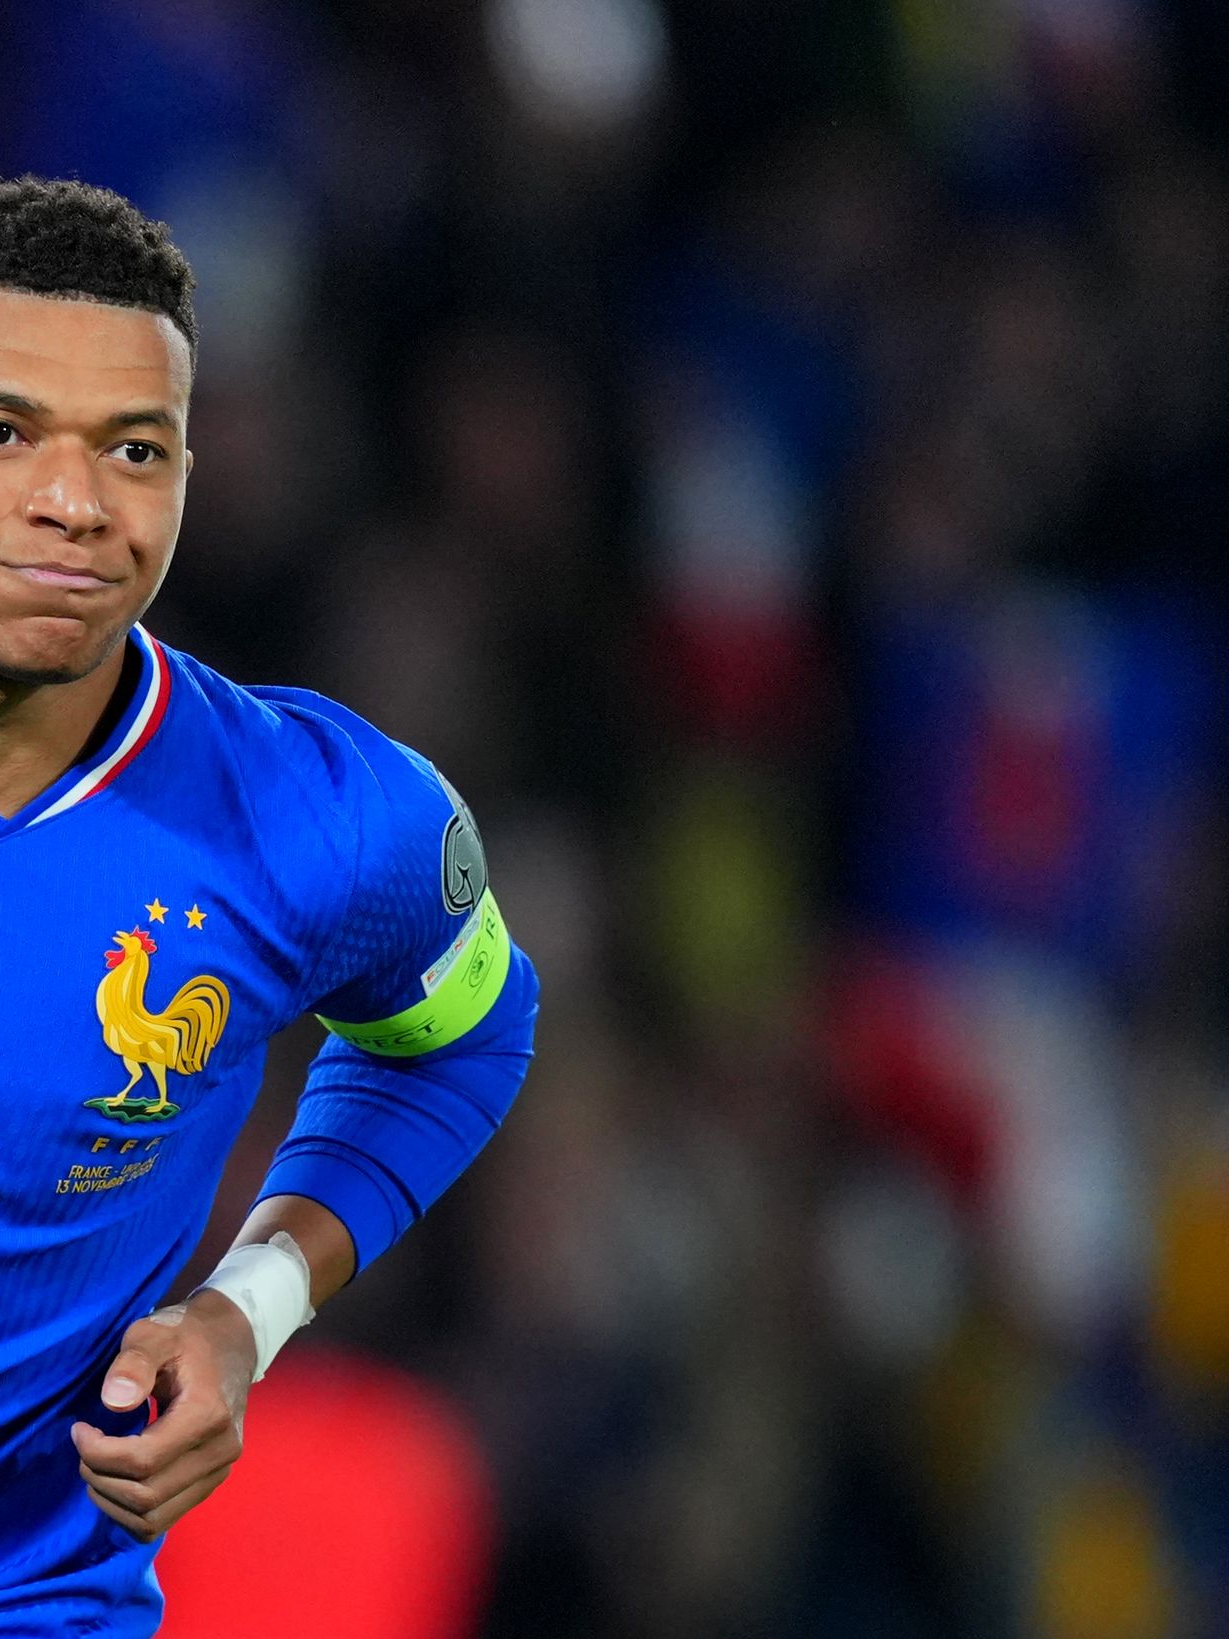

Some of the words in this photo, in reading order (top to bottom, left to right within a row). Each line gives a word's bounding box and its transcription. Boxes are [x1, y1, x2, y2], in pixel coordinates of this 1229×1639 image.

[346, 1020, 435, 1047] PECT
[68, 1164, 113, 1179] FRANCE
[55, 1179, 71, 1194] 13
